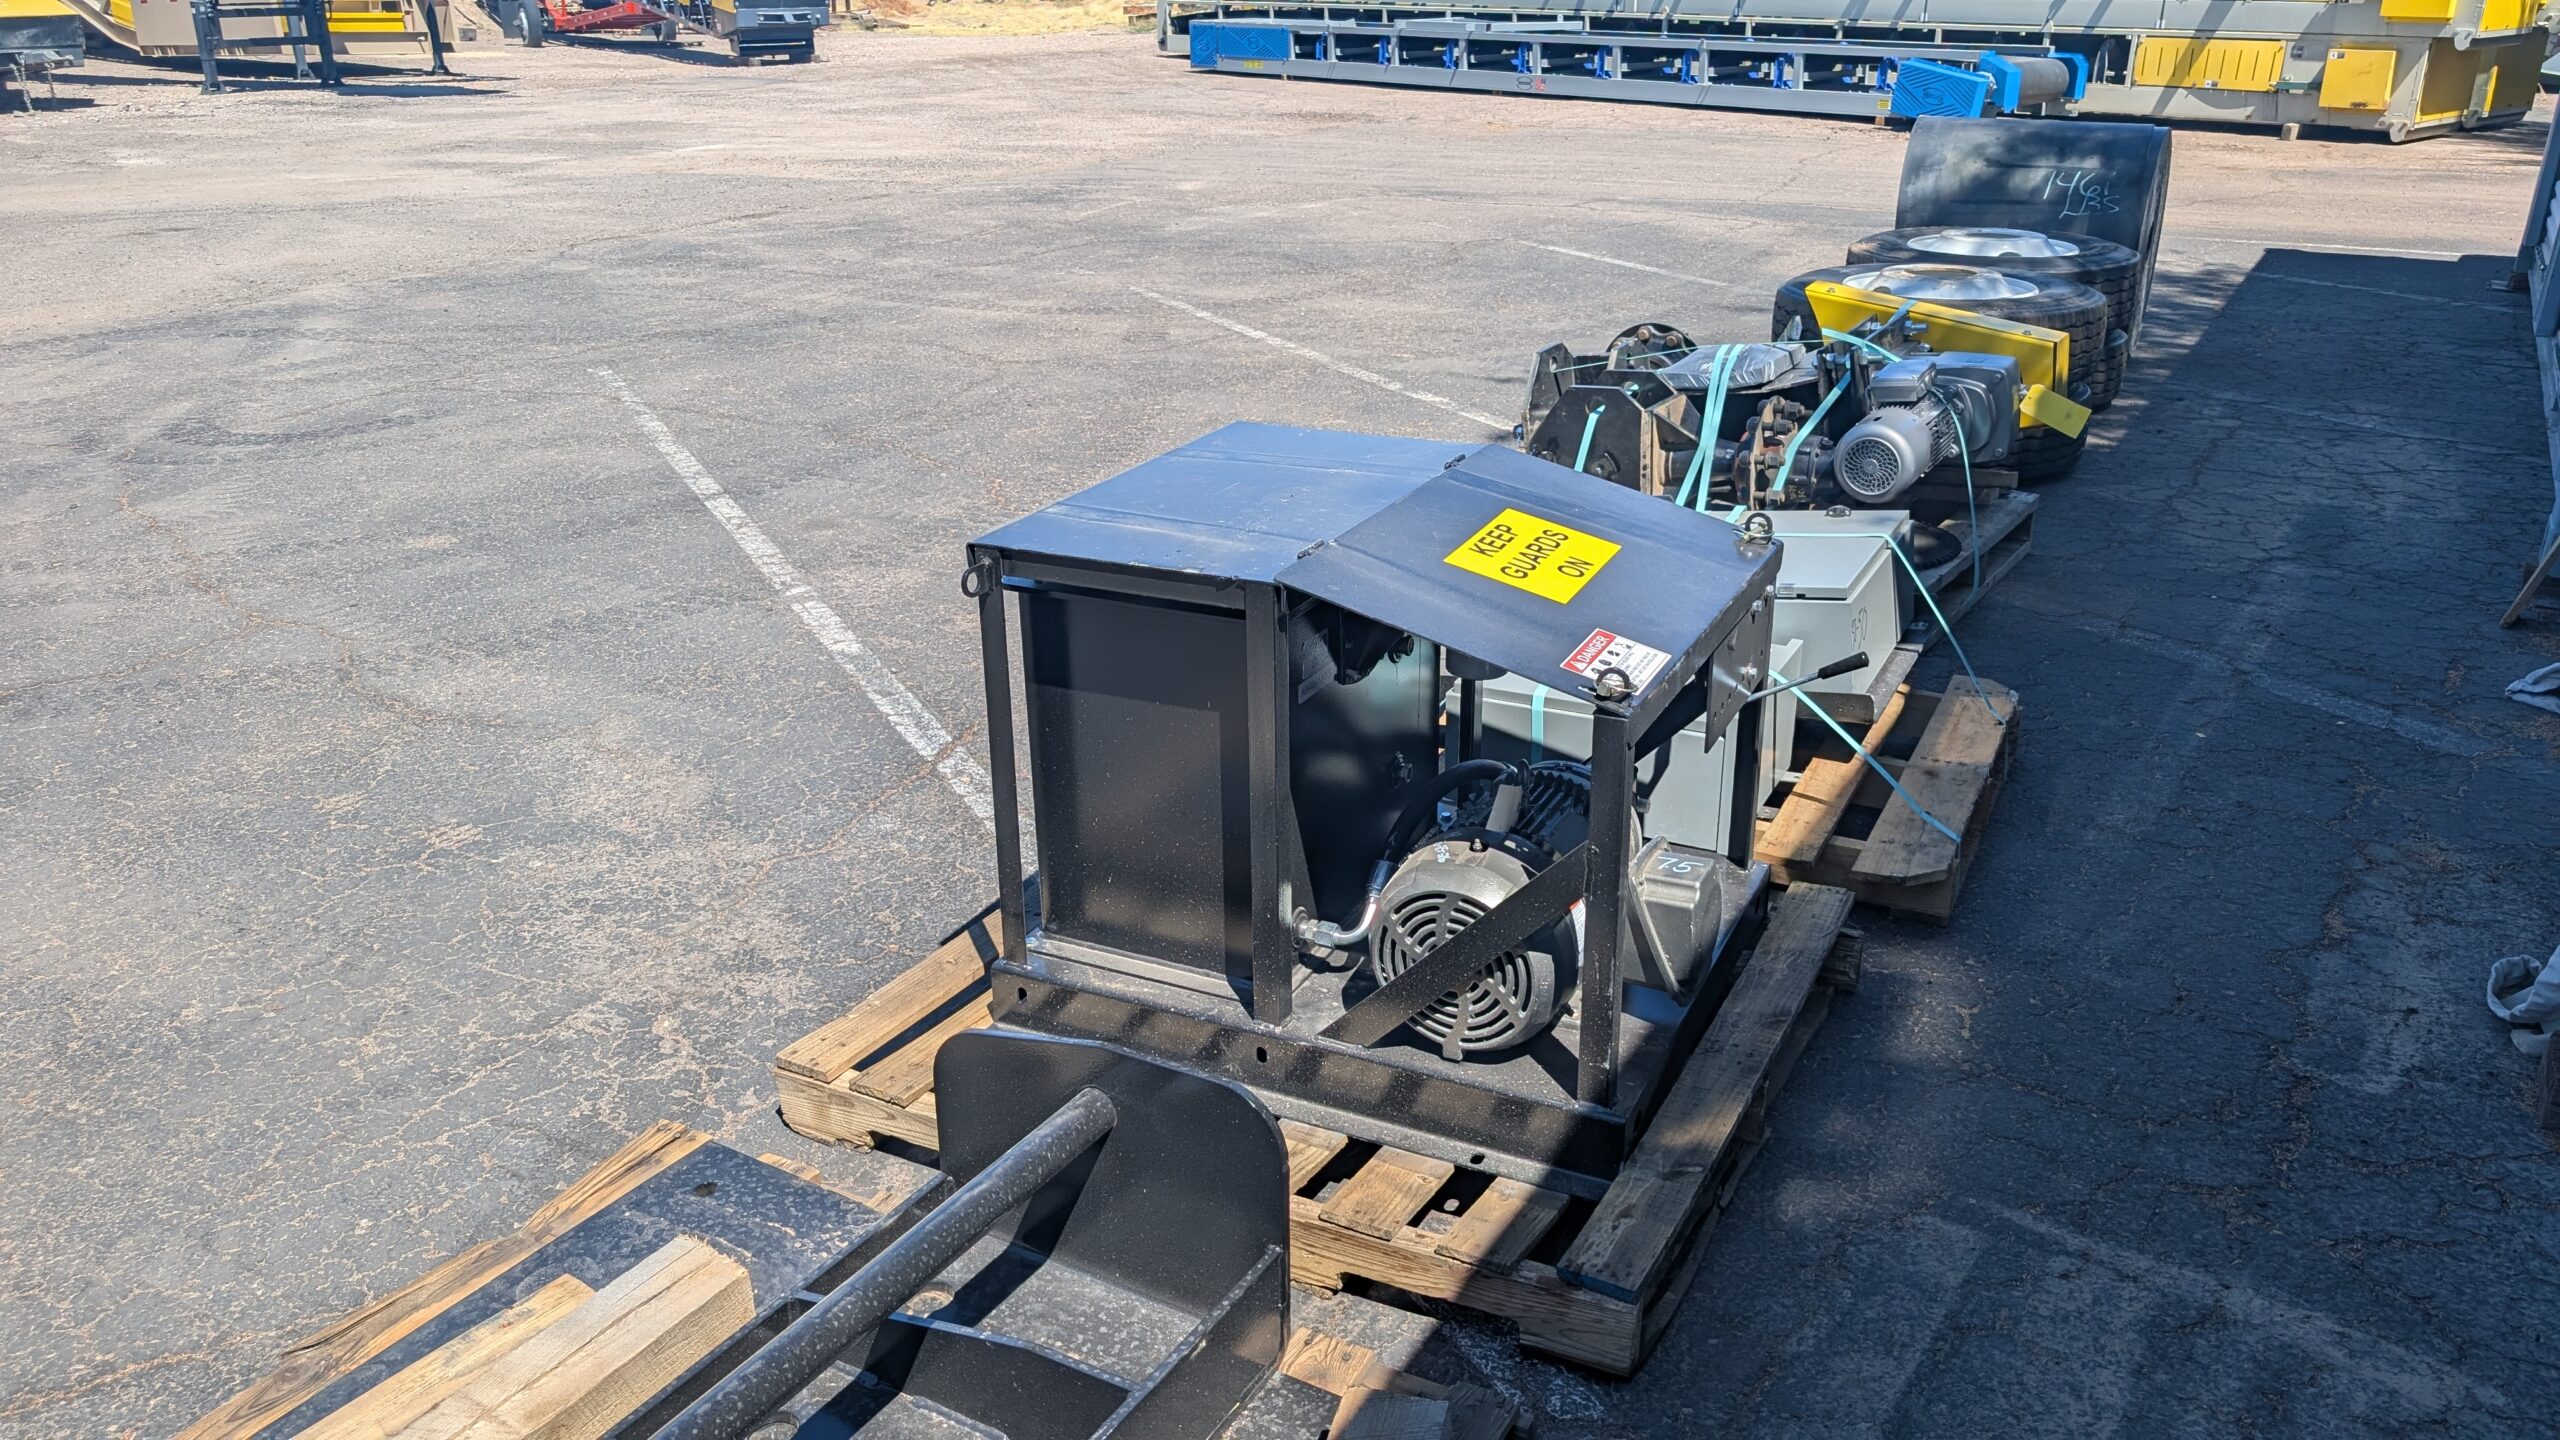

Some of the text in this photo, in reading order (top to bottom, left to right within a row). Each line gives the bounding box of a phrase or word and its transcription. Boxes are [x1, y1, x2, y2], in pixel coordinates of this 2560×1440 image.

[1468, 523, 1519, 557] KEEP
[1500, 529, 1569, 579] GUARDS
[1557, 556, 1595, 578] ON
[1576, 635, 1611, 663] DANGER
